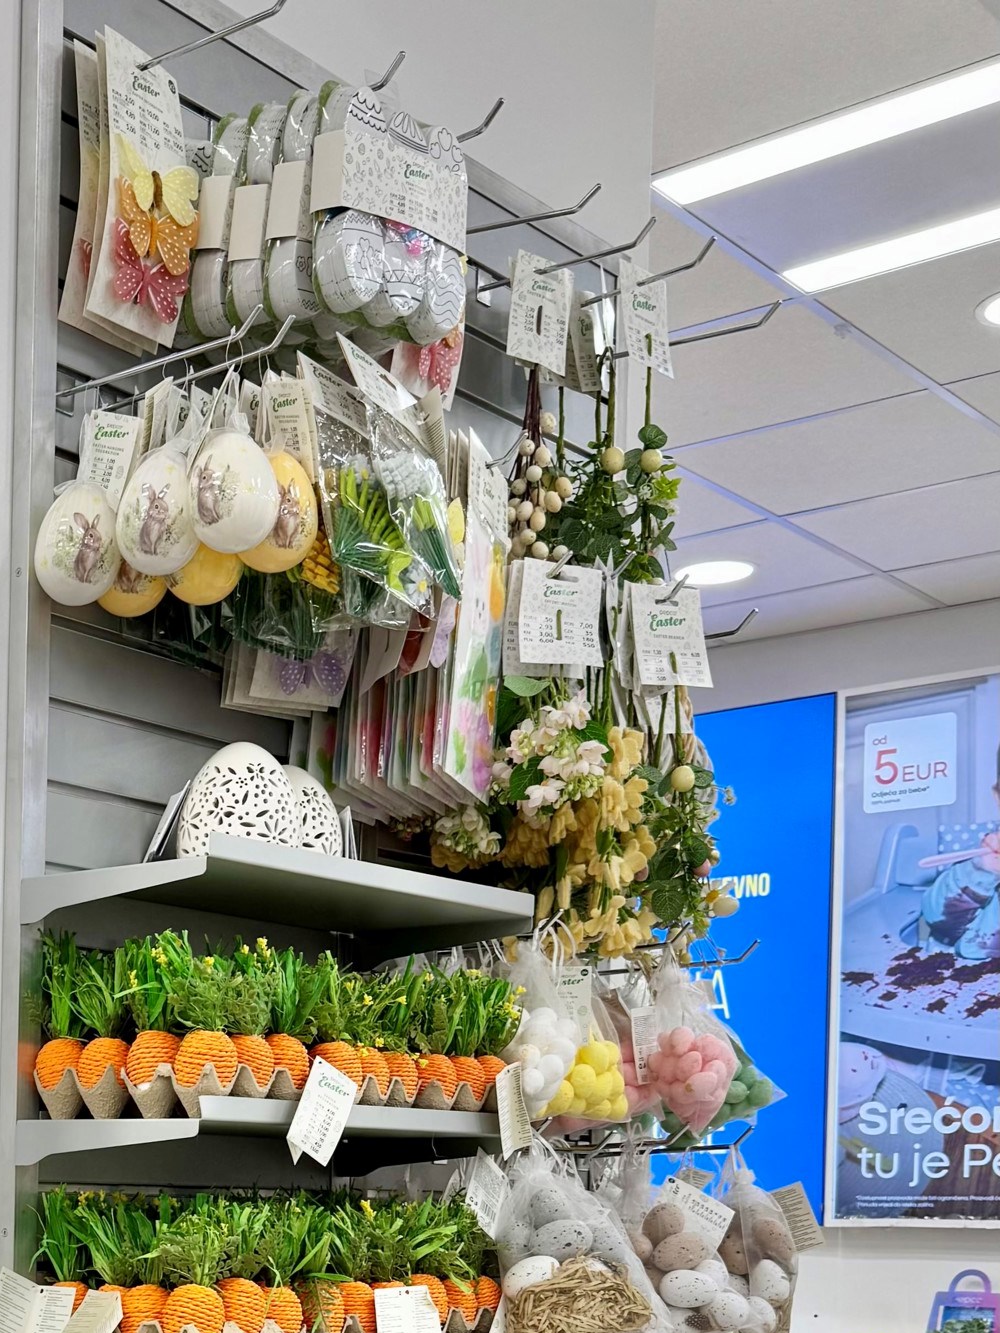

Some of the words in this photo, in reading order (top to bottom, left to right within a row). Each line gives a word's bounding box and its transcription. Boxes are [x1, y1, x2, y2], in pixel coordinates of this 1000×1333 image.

[131, 72, 160, 98] Easter
[403, 160, 430, 179] Easter
[532, 279, 556, 293] Easter
[631, 290, 656, 311] Easter
[270, 396, 298, 412] Easter
[94, 424, 130, 440] Easter
[542, 583, 578, 598] Easter
[579, 622, 593, 630] 7,00
[647, 611, 686, 631] Easter
[872, 735, 887, 746] od
[874, 748, 898, 785] 5
[902, 761, 948, 783] EUR
[562, 978, 585, 987] ster
[318, 1072, 350, 1097] Easter
[857, 1147, 899, 1179] tu
[909, 1143, 950, 1188] je
